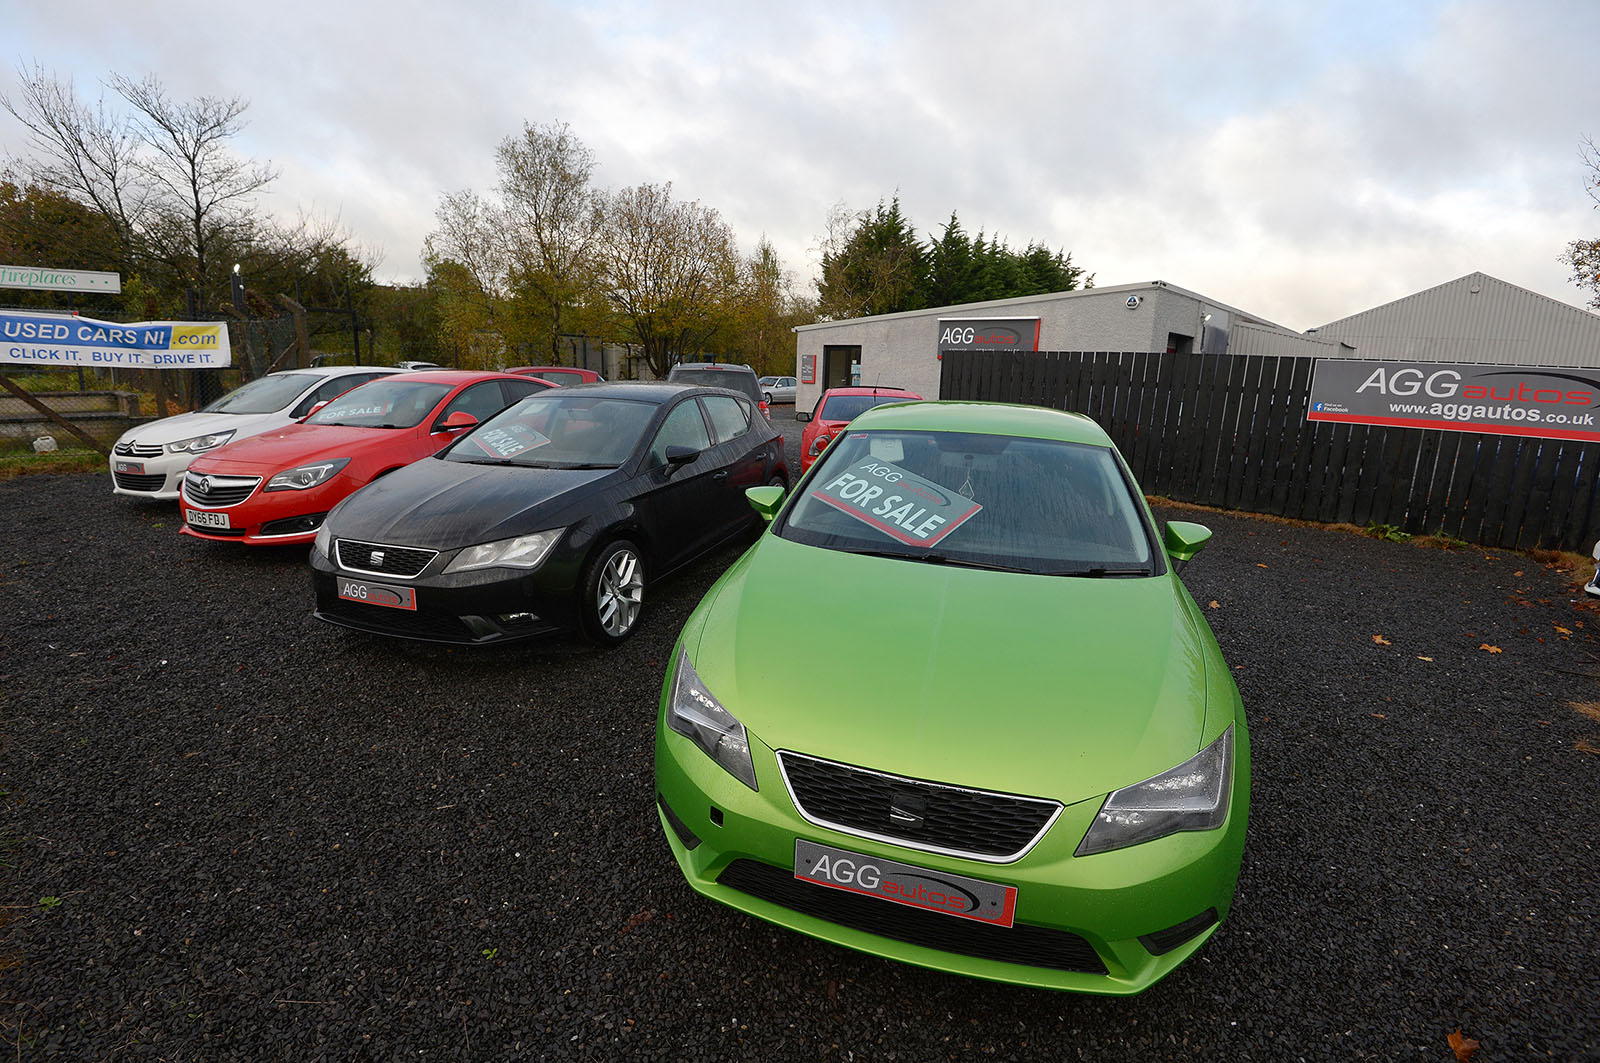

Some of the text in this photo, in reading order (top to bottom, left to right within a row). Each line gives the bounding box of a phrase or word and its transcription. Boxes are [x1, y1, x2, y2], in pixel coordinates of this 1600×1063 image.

[0, 267, 76, 286] fireplaces
[4, 321, 70, 340] USED
[77, 326, 137, 345] CARS
[144, 330, 164, 345] NI
[940, 327, 1015, 344] AGG autos
[9, 347, 214, 364] CLICK IT. BUY IT. DRIVE IT.
[1356, 367, 1593, 405] AGG autos
[318, 410, 346, 421] FOR
[349, 406, 382, 416] SALE
[1389, 402, 1594, 425] www.aggautos.co.uk
[860, 462, 903, 483] AGG
[825, 472, 947, 539] FOR SALE
[343, 582, 367, 599] AGG
[810, 854, 882, 889] AGG
[882, 880, 966, 909] autos
